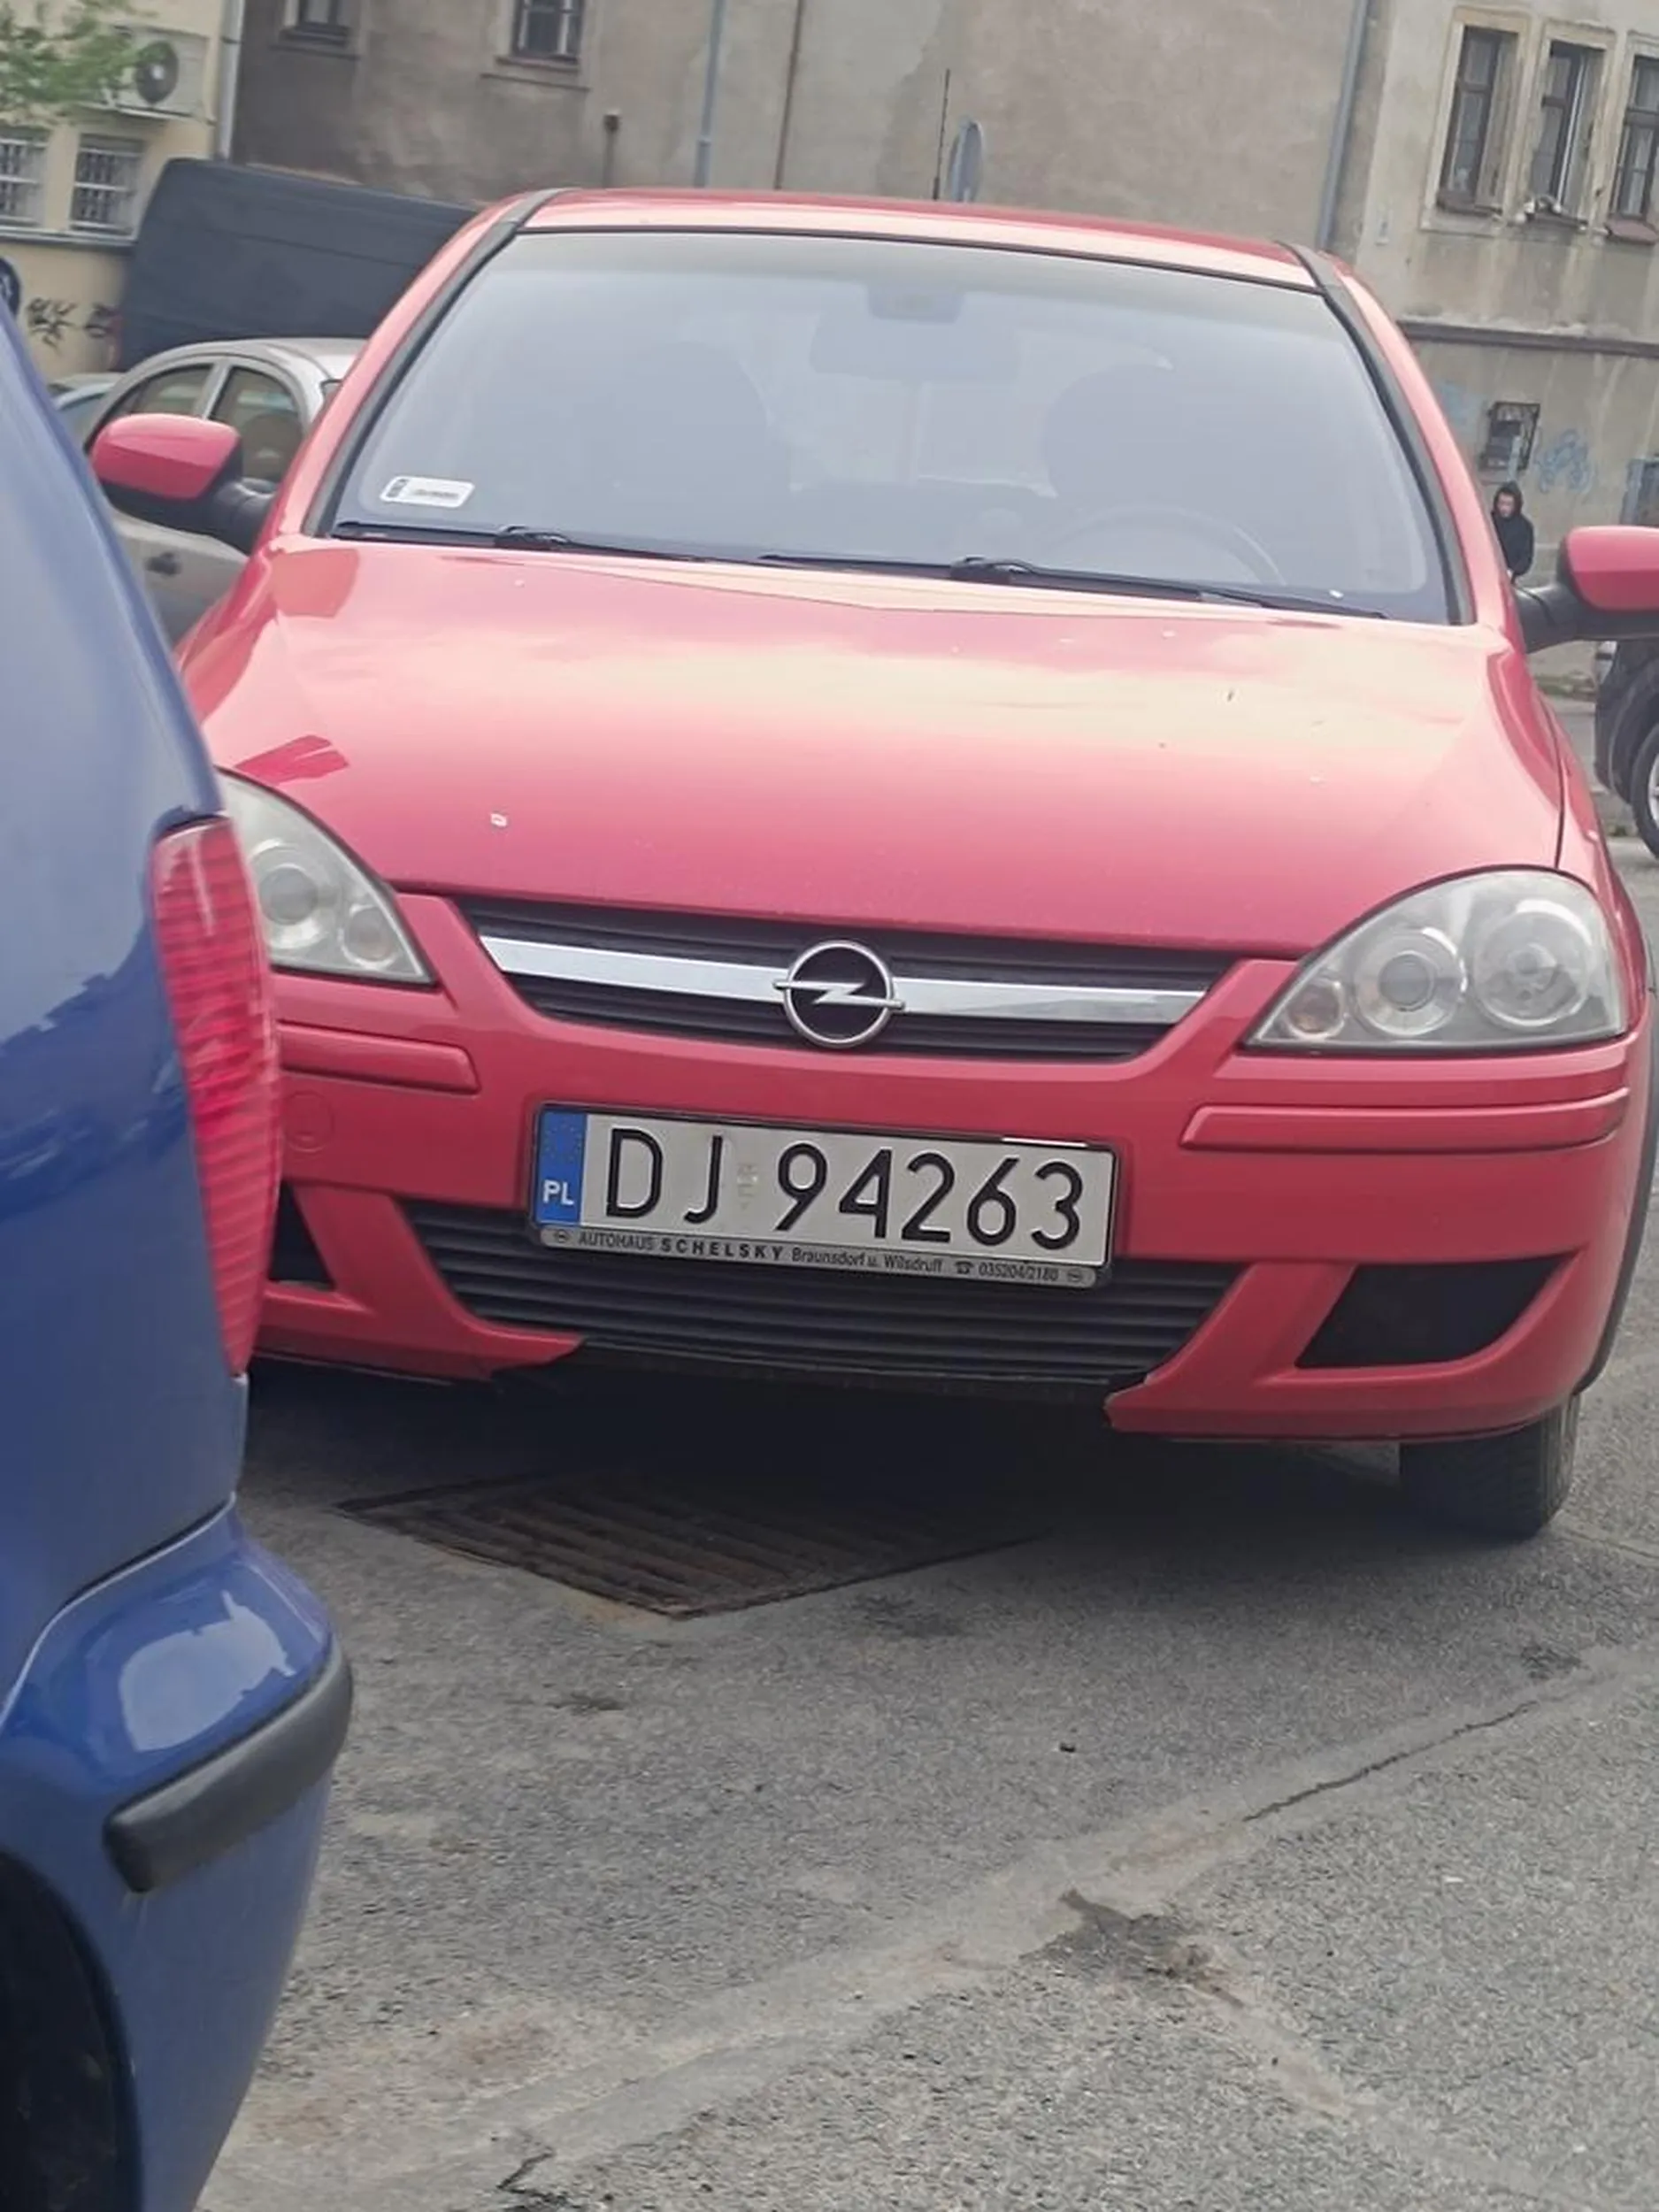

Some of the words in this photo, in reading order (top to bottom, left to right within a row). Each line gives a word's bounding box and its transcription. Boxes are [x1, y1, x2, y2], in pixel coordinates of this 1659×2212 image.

[542, 1179, 574, 1205] PL
[606, 1128, 723, 1224] DJ
[775, 1142, 1084, 1249] 94263
[579, 1231, 654, 1250] AUTOHAUS
[661, 1238, 783, 1261] SCHELSKY
[792, 1247, 865, 1266] Braunsdorf
[885, 1254, 944, 1272] Wilsdruff
